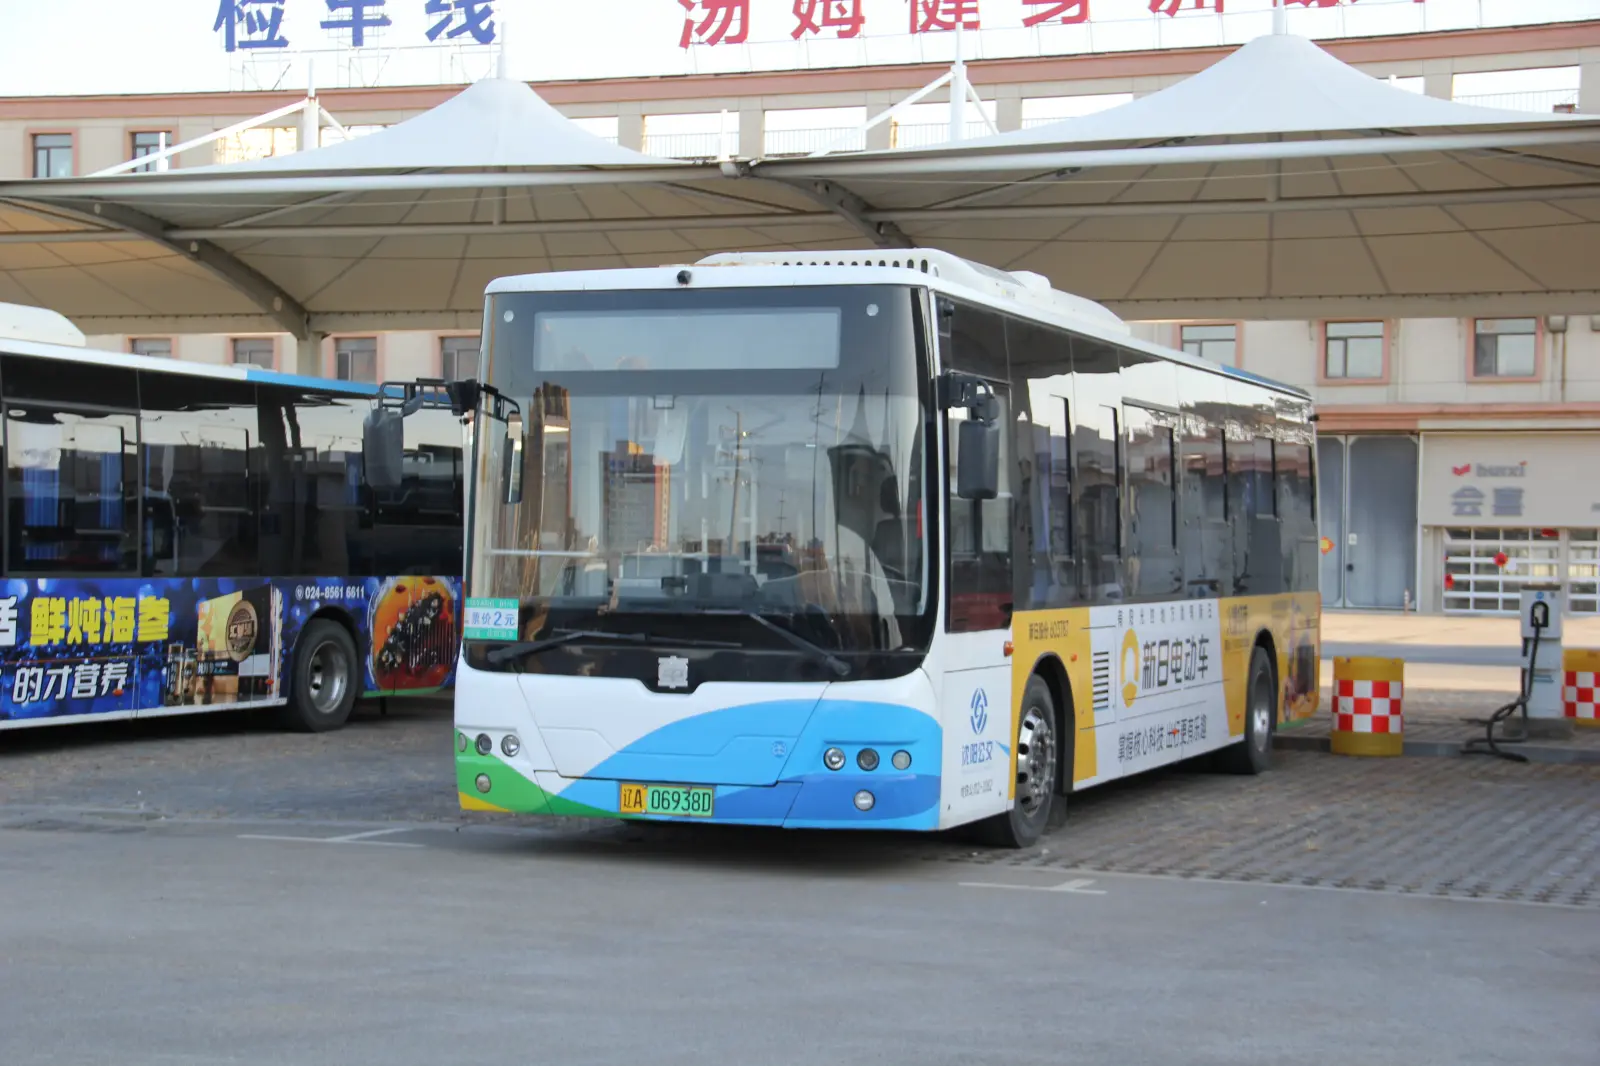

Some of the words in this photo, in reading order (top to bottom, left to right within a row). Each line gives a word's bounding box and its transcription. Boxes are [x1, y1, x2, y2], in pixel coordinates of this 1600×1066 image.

[305, 585, 344, 600] 024-8561
[346, 585, 365, 599] 6611
[12, 661, 129, 704] 的才营养
[1142, 634, 1209, 690] 新日电动车
